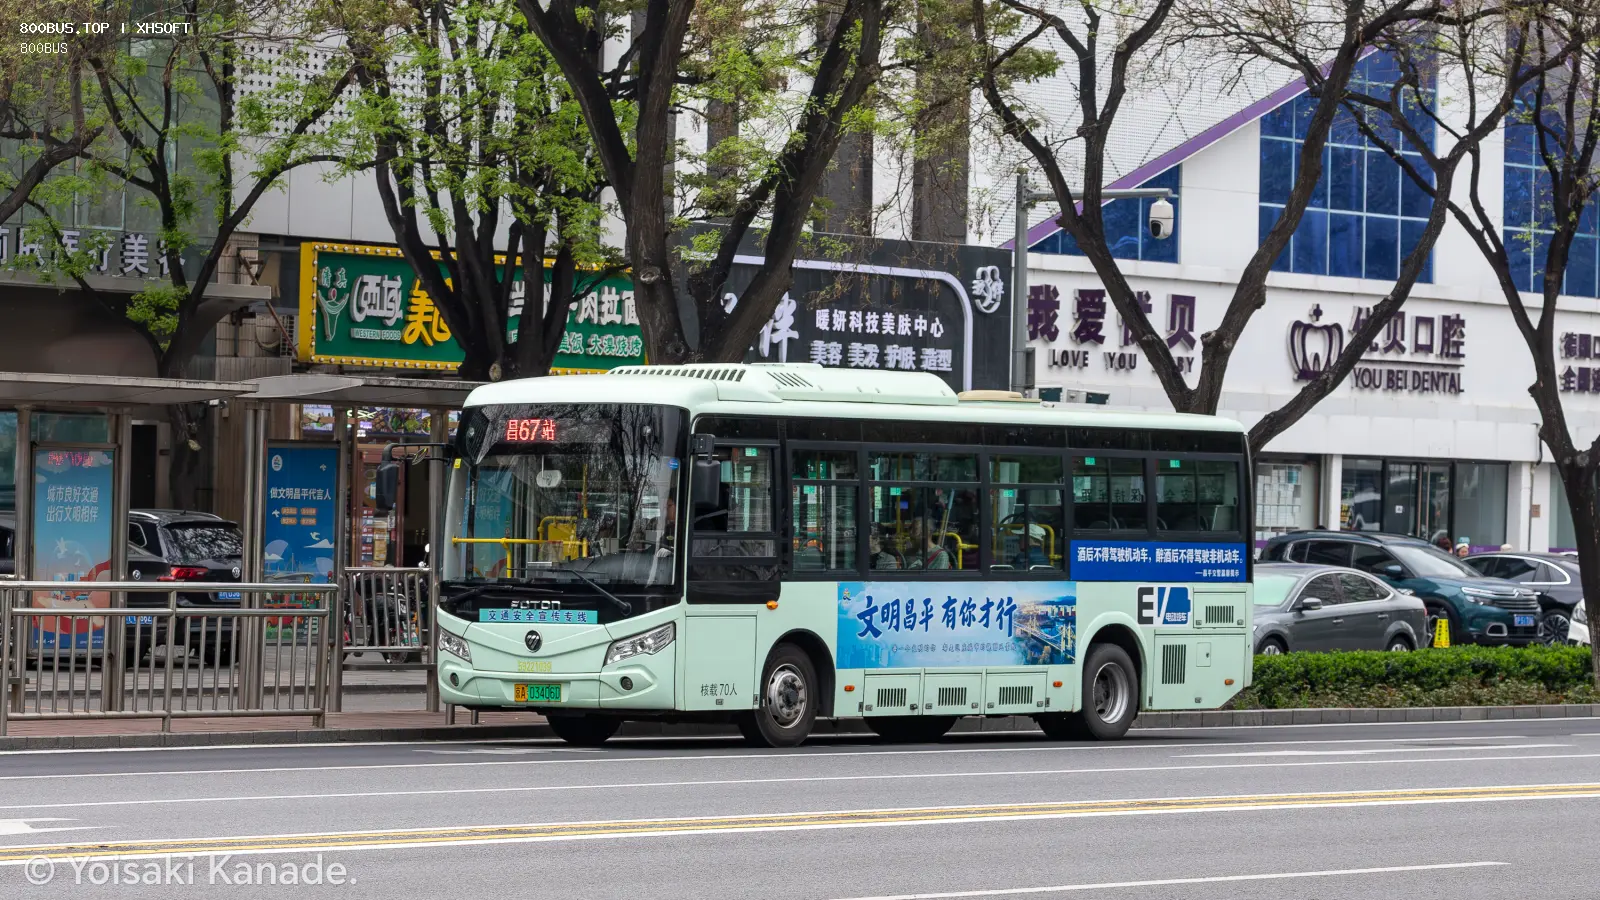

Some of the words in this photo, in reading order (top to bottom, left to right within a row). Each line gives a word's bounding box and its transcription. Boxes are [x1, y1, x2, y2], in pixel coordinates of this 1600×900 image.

[352, 328, 381, 340] WESTERN
[815, 308, 945, 338] 暖妍科技美肤中心
[810, 340, 843, 367] 美容
[847, 342, 880, 369] 美发
[884, 344, 917, 370] 护肤
[919, 347, 953, 372] 造型
[1050, 349, 1089, 368] LOVE
[1107, 352, 1138, 370] YOU
[1352, 367, 1383, 389] YOU
[1386, 369, 1409, 391] BEI
[1411, 370, 1465, 393] DENTAL
[488, 610, 587, 622] 交通安全宣传专线
[856, 595, 935, 639] 文明昌平
[941, 595, 1018, 638] 有你才行
[700, 683, 738, 697] 核载70人
